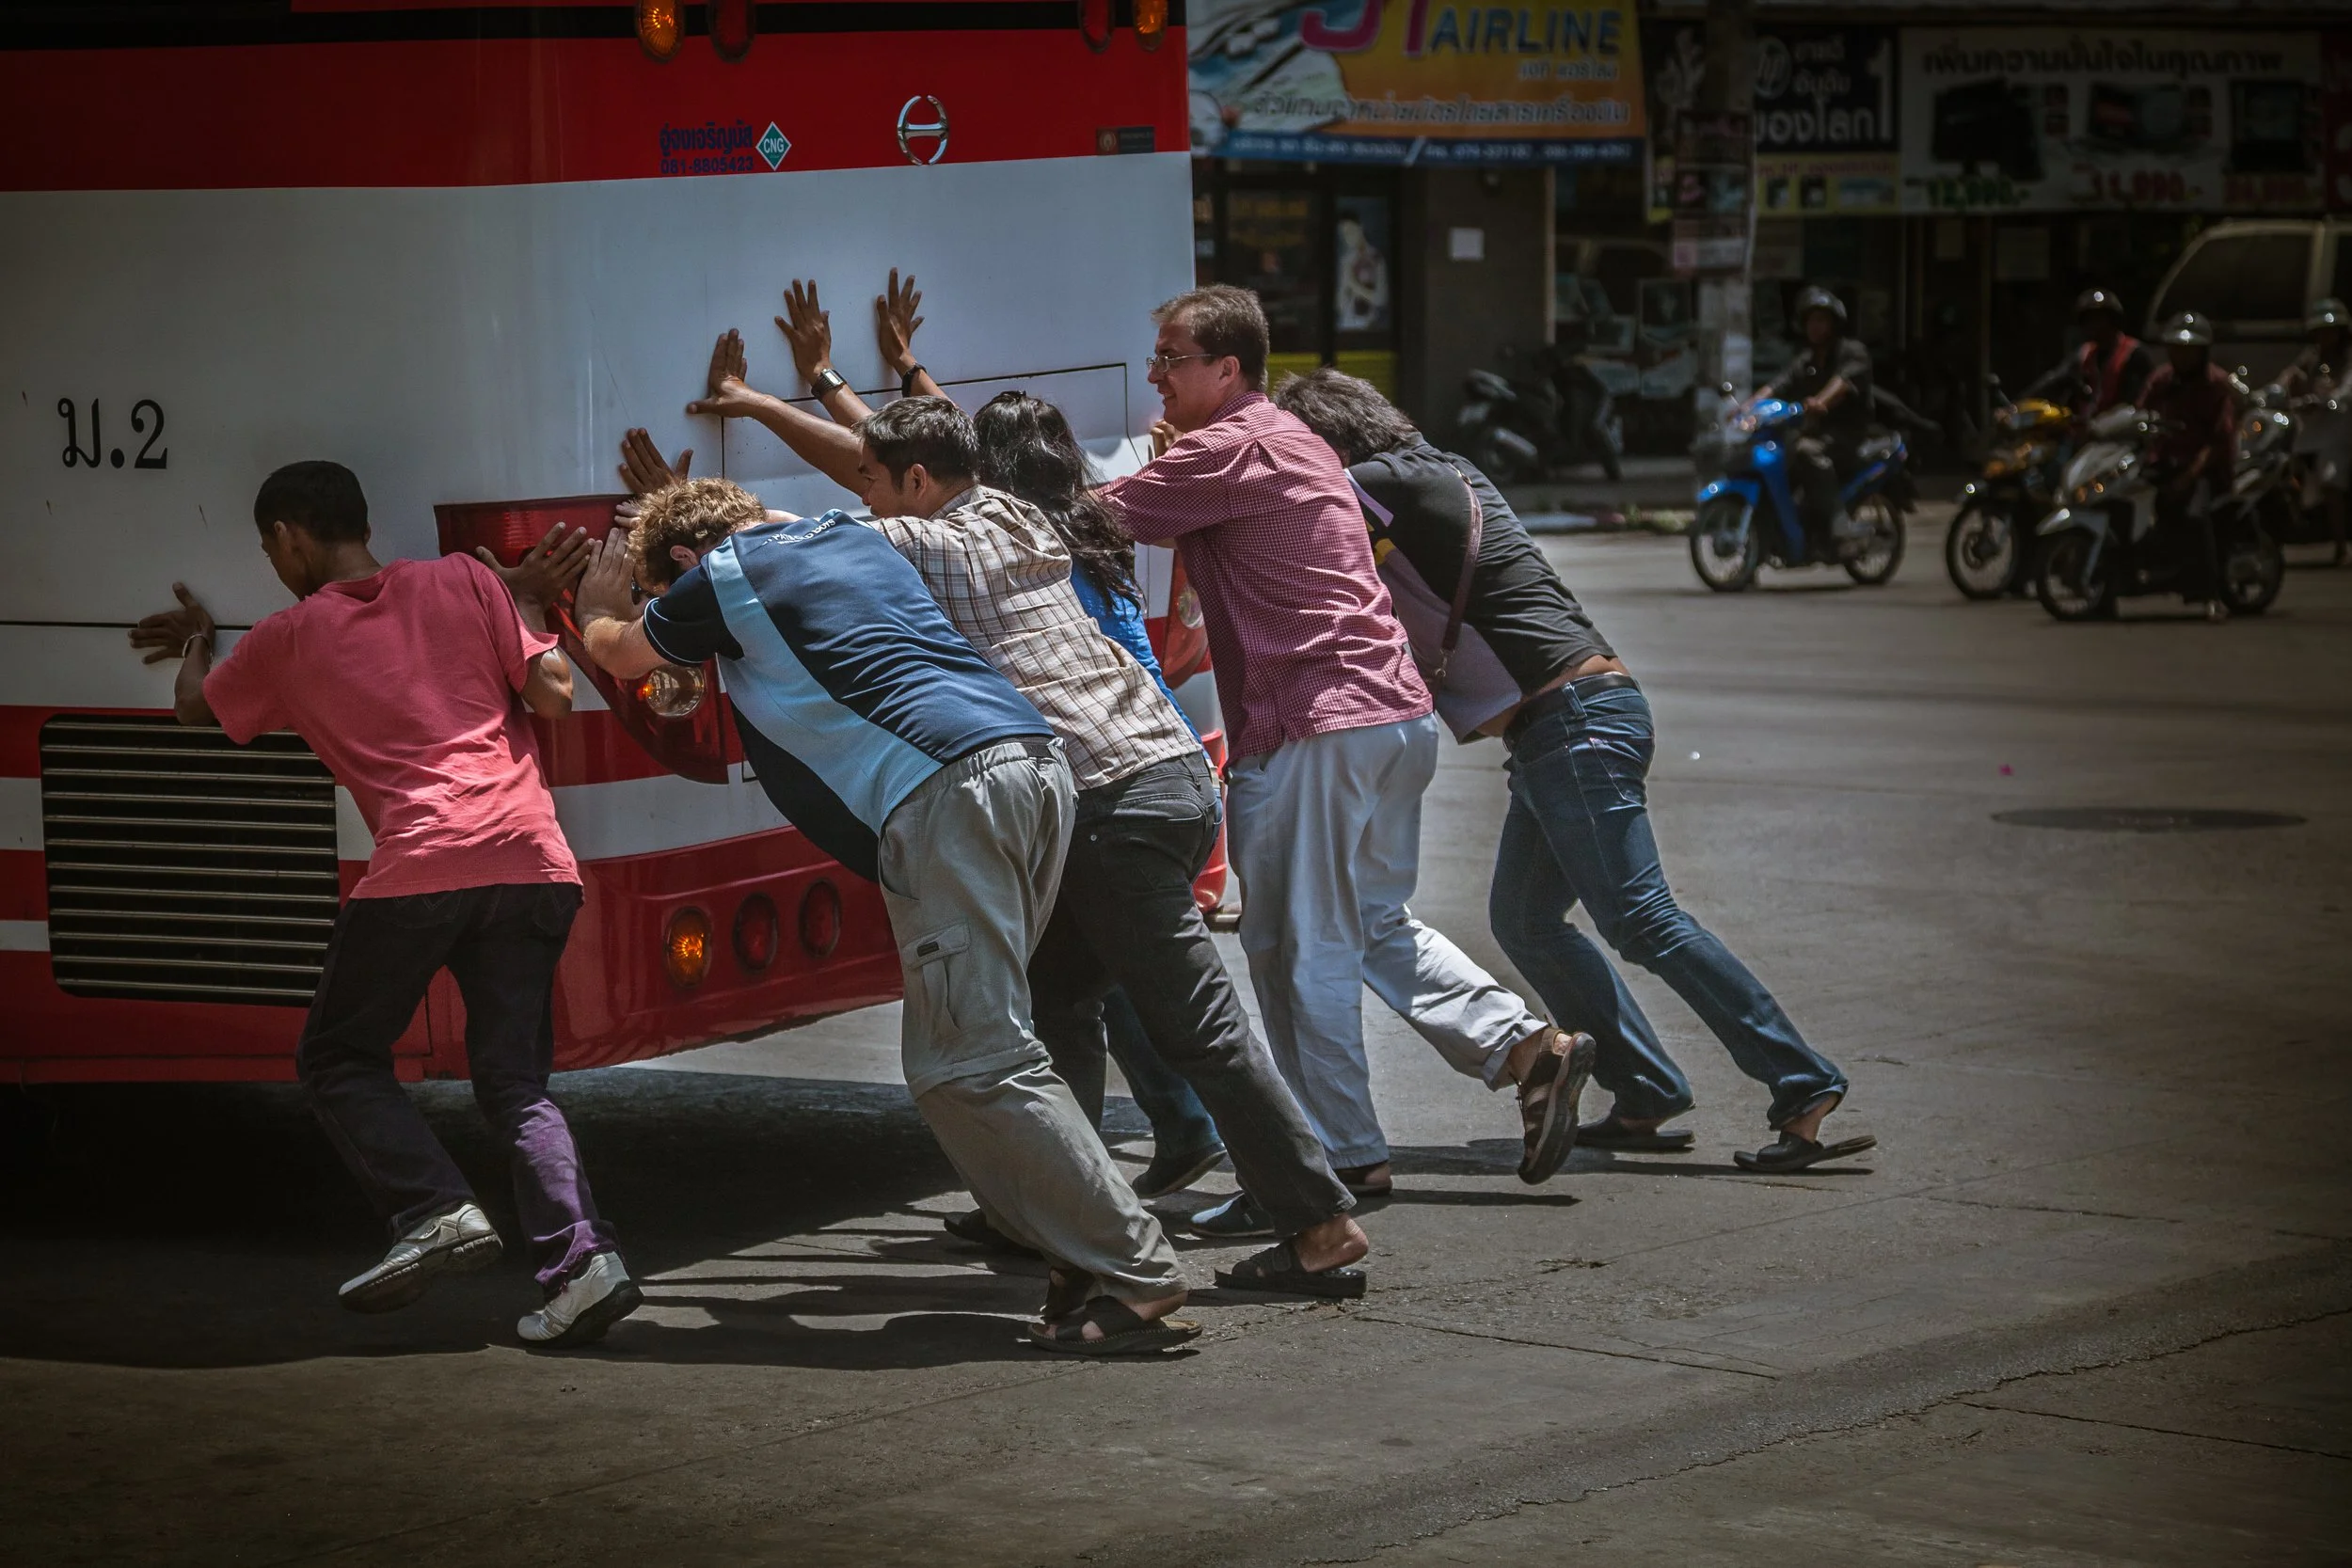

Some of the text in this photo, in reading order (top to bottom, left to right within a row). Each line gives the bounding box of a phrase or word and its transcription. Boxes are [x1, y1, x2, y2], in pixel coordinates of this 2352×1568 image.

[1429, 8, 1621, 54] AIRLINE
[763, 137, 785, 154] CNG
[660, 156, 753, 174] 081-8805423
[57, 398, 167, 468] ม.2
[811, 518, 836, 534] BOYS
